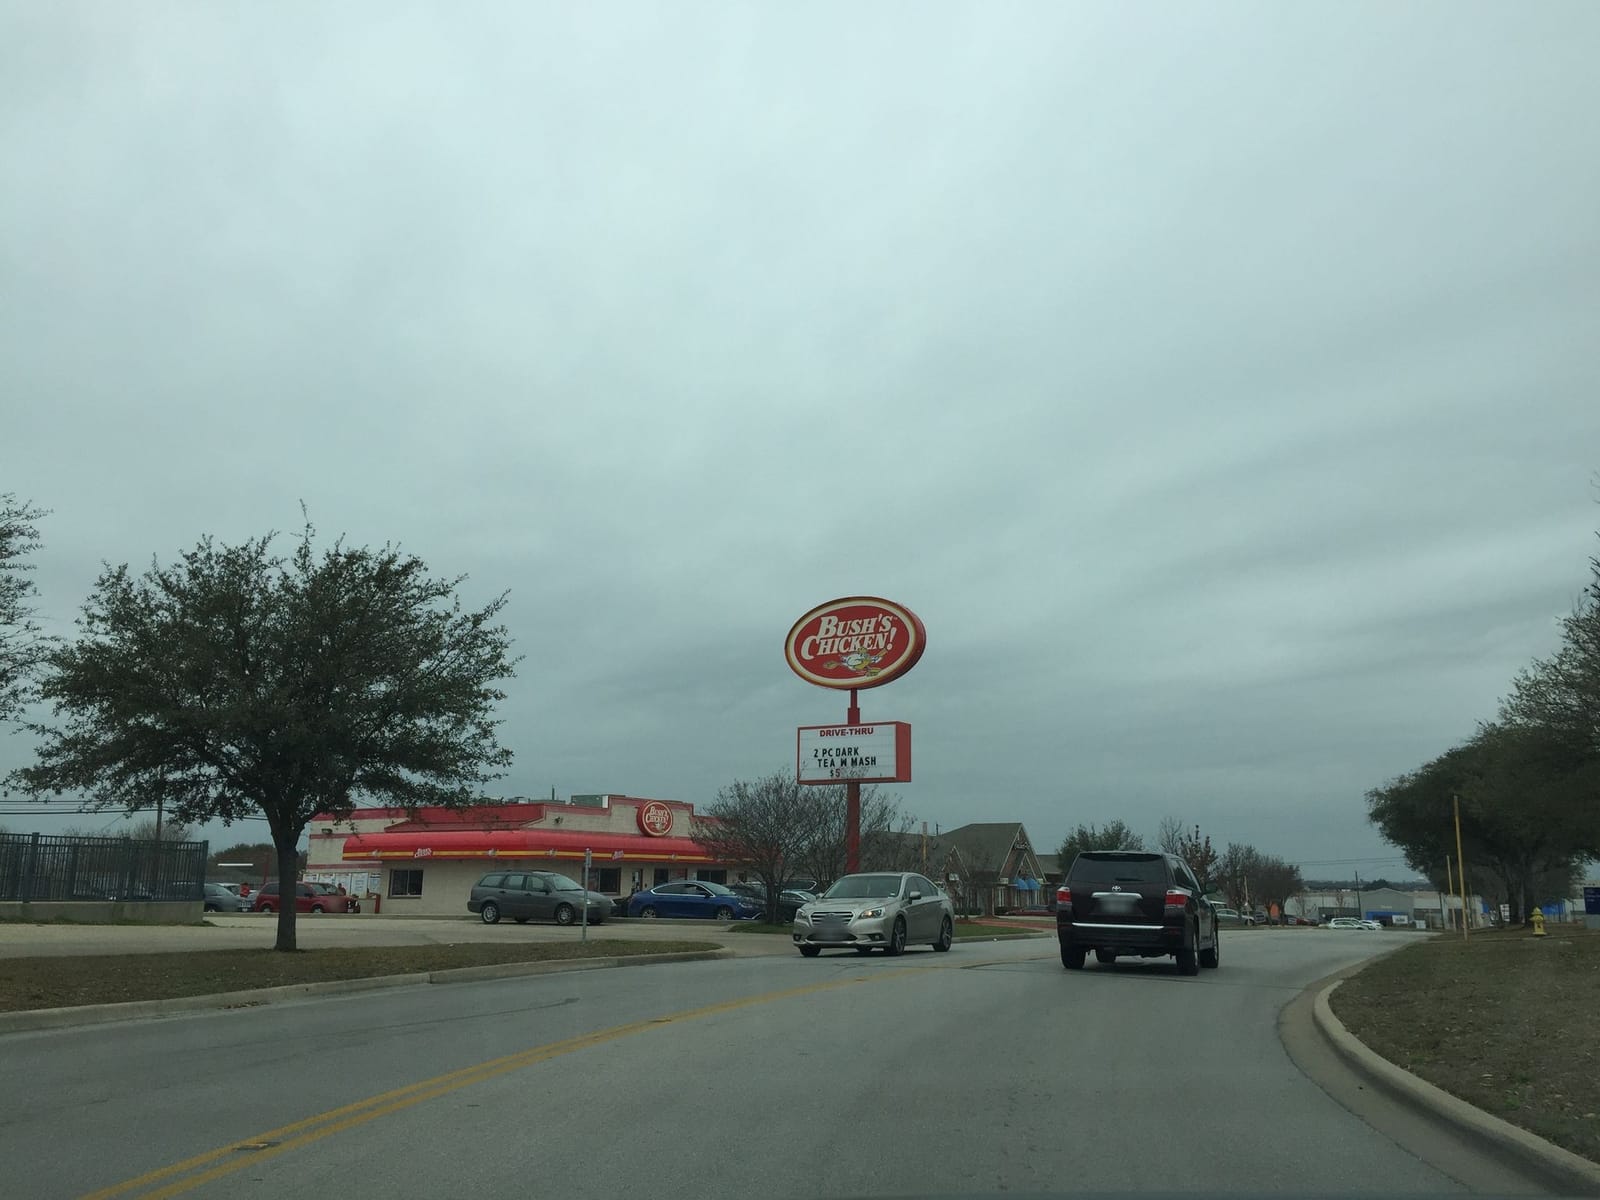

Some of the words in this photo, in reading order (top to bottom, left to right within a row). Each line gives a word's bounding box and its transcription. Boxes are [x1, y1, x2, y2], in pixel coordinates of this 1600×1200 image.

[816, 614, 894, 640] BUSH'S
[801, 624, 897, 660] CHICKEN!
[819, 727, 874, 737] DRIVE-THRU
[813, 748, 819, 757] 2
[822, 748, 833, 757] PC
[835, 747, 859, 757] DARK
[817, 758, 835, 767] TEA
[850, 757, 877, 766] MASH
